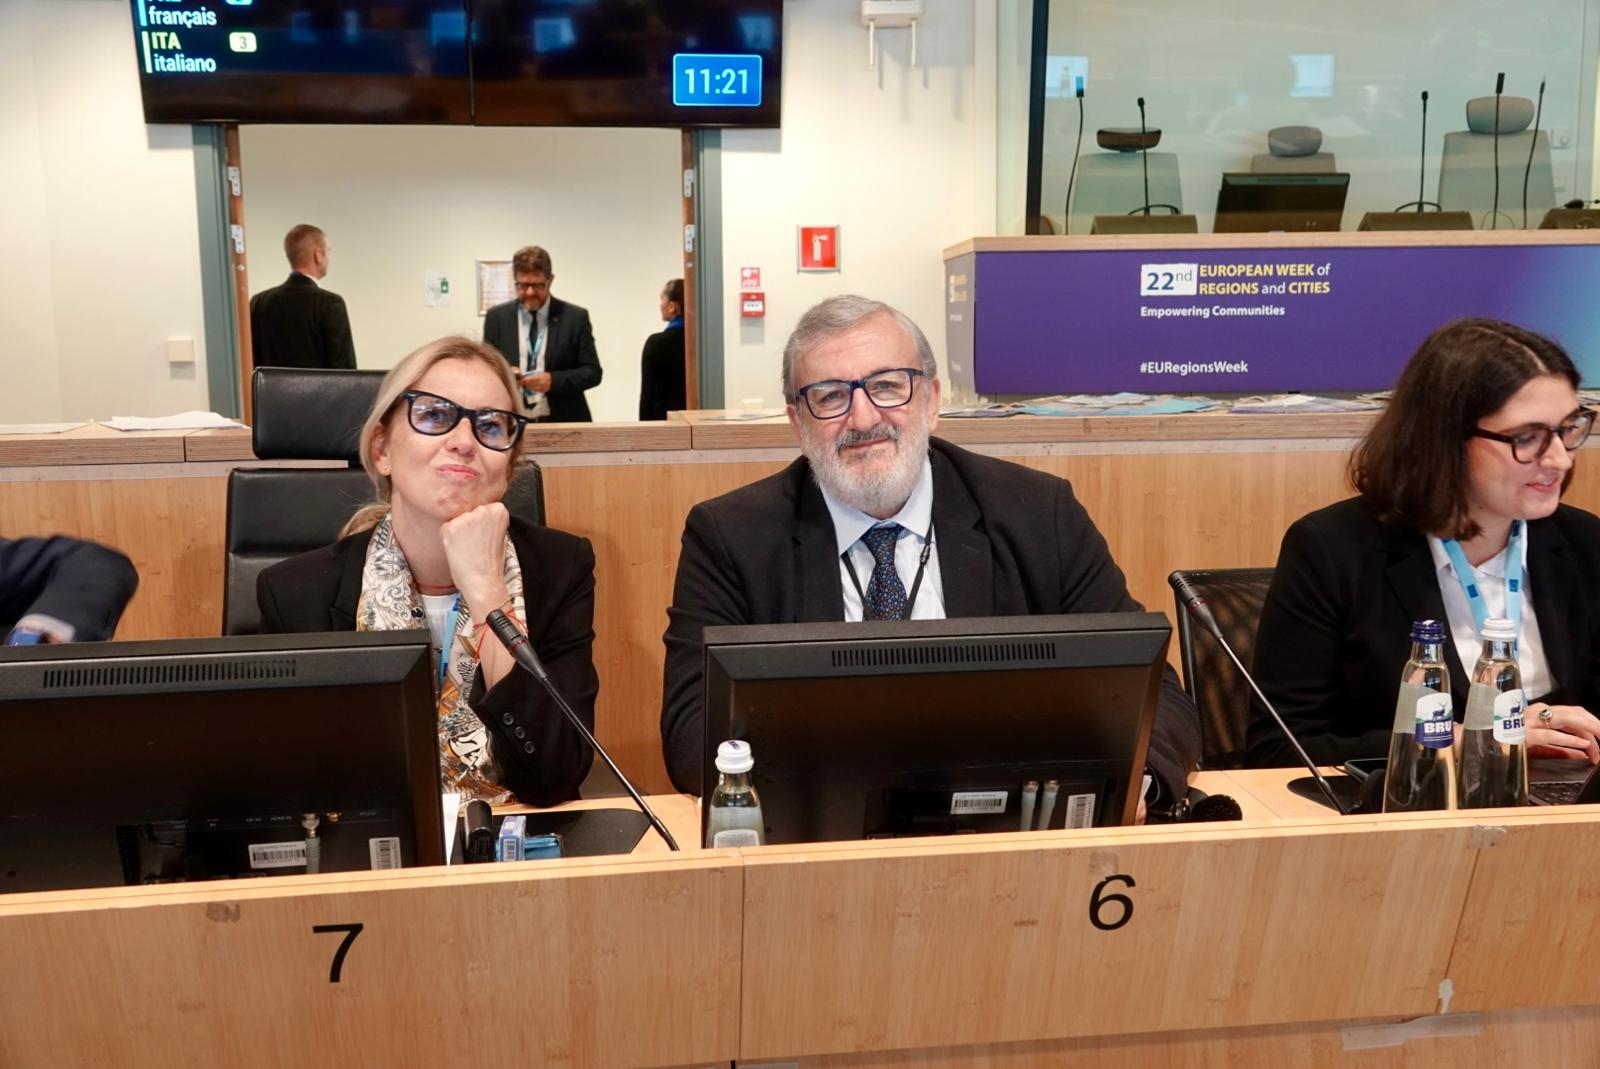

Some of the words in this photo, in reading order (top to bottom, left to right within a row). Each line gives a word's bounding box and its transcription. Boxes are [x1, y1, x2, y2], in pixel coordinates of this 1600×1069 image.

[148, 5, 218, 29] français
[151, 31, 182, 50] ITA
[238, 35, 248, 50] 3
[153, 53, 217, 73] italiano
[684, 68, 748, 95] 11:21
[1200, 264, 1273, 277] EUROPEAN
[1275, 263, 1315, 276] WEEK
[1316, 262, 1331, 276] of
[1146, 269, 1193, 291] 22nd
[1200, 282, 1259, 295] REGIONS
[1261, 281, 1286, 294] and
[1288, 281, 1331, 294] CITIES
[1140, 306, 1210, 319] Empowering
[1212, 304, 1286, 317] Communities
[1140, 360, 1249, 376] #EURegionsWeek
[1424, 720, 1452, 734] BRU
[1089, 874, 1136, 931] 6
[312, 922, 364, 984] 7
